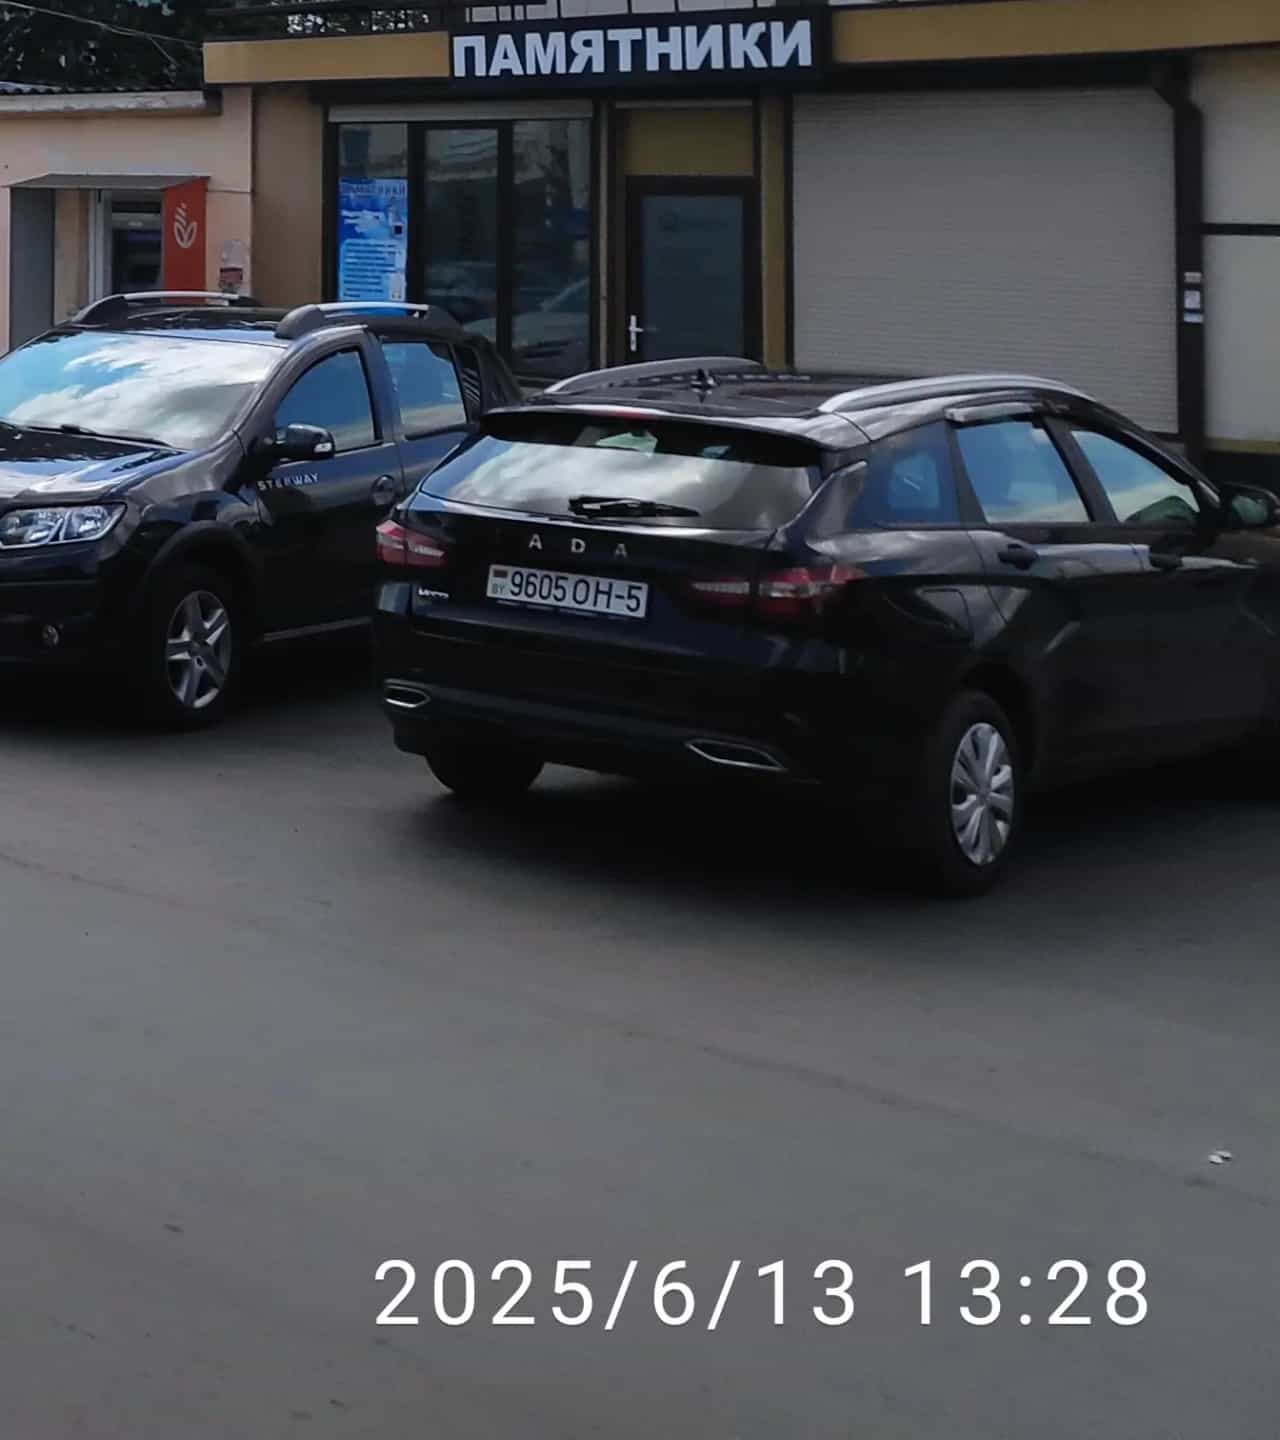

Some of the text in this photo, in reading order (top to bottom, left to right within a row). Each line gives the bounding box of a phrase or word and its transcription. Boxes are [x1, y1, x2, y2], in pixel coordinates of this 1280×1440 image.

[453, 20, 812, 77] ПАМЯТНИКИ
[496, 528, 628, 559] ADA
[510, 570, 569, 602] 9605
